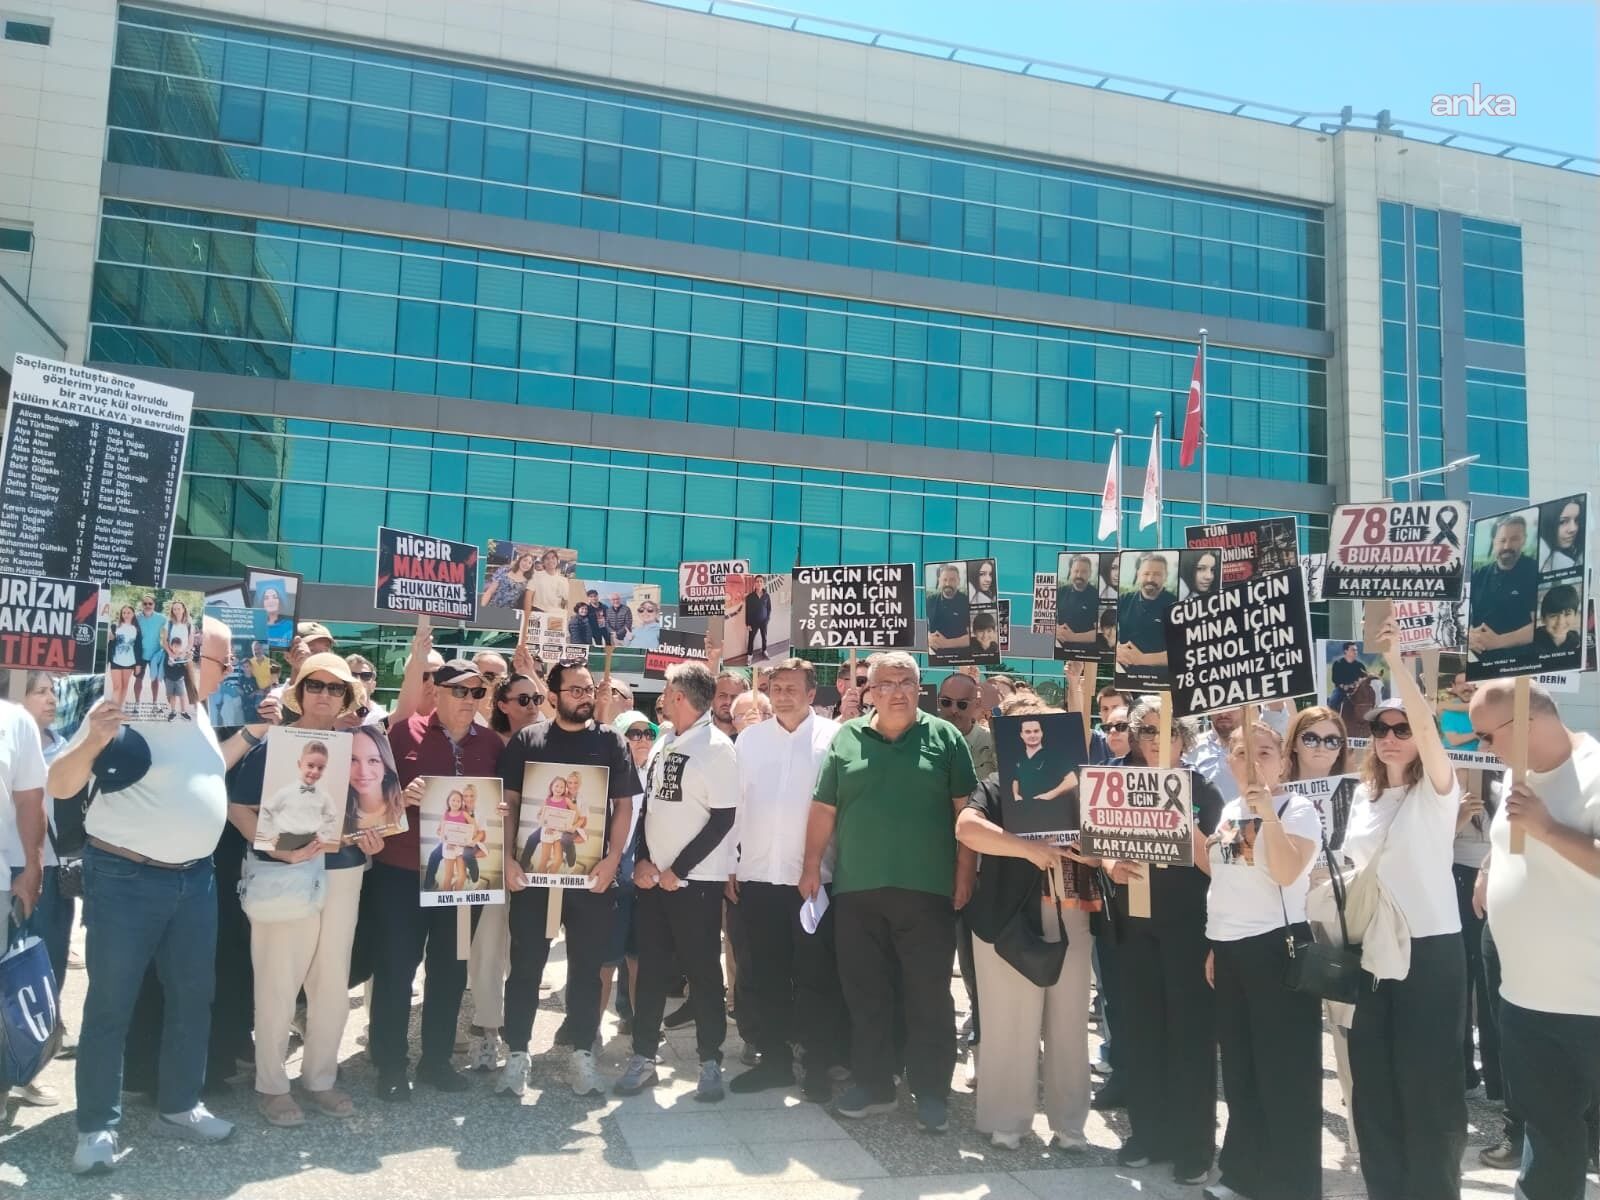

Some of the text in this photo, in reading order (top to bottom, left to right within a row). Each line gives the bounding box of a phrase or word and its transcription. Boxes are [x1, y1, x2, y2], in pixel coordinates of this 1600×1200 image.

[15, 355, 136, 389] Saçlarım tutuştu önce
[42, 373, 168, 407] gözlerim yandı kavruldu
[13, 391, 49, 406] külüm
[144, 419, 186, 433] savruldu
[59, 387, 184, 422] bir avuç kül oluverdim
[1203, 524, 1228, 538] TÜM
[1340, 506, 1431, 545] 78 CAN
[1395, 527, 1422, 542] İÇİN
[396, 535, 452, 562] HİÇBİR
[1189, 531, 1257, 548] SORUMLULAR
[1347, 545, 1443, 564] BURADAYIZ
[393, 555, 465, 584] MAKAM
[683, 562, 730, 586] 78 CAN
[799, 566, 902, 586] GÜLÇİN İÇİN
[400, 580, 461, 600] HUKUKTAN
[811, 584, 897, 602] MİNA İÇİN
[1339, 578, 1446, 591] KARTALKAYA
[1349, 589, 1435, 598] AİLE PLATFORMU
[388, 593, 473, 617] ÜSTÜN DEĞİLDİR!
[809, 601, 902, 618] ŞENOL İÇİN
[1170, 575, 1290, 625] GÜLÇİN İÇİN
[800, 617, 908, 630] 78 CANIMIZ İÇİN
[1185, 603, 1287, 646] MİNA İÇİN
[809, 631, 899, 647] ADALET
[1185, 626, 1295, 670] ŞENOL İÇİN
[1176, 649, 1303, 690] 78 CANIMIZ İÇİN
[1540, 675, 1566, 685] DERİN
[1189, 670, 1294, 711] ADALET
[1087, 771, 1159, 808] 78 CAN
[1311, 780, 1330, 793] OTEL
[1132, 791, 1153, 807] İÇİN
[1097, 808, 1173, 828] BURADAYIZ
[1093, 838, 1180, 856] KARTALKAYA
[1103, 850, 1172, 861] AİLE PLATFORMU
[531, 876, 548, 885] ALYA
[560, 875, 585, 886] KÜBRA
[438, 894, 454, 903] ALYA
[465, 892, 490, 903] KÜBRA
